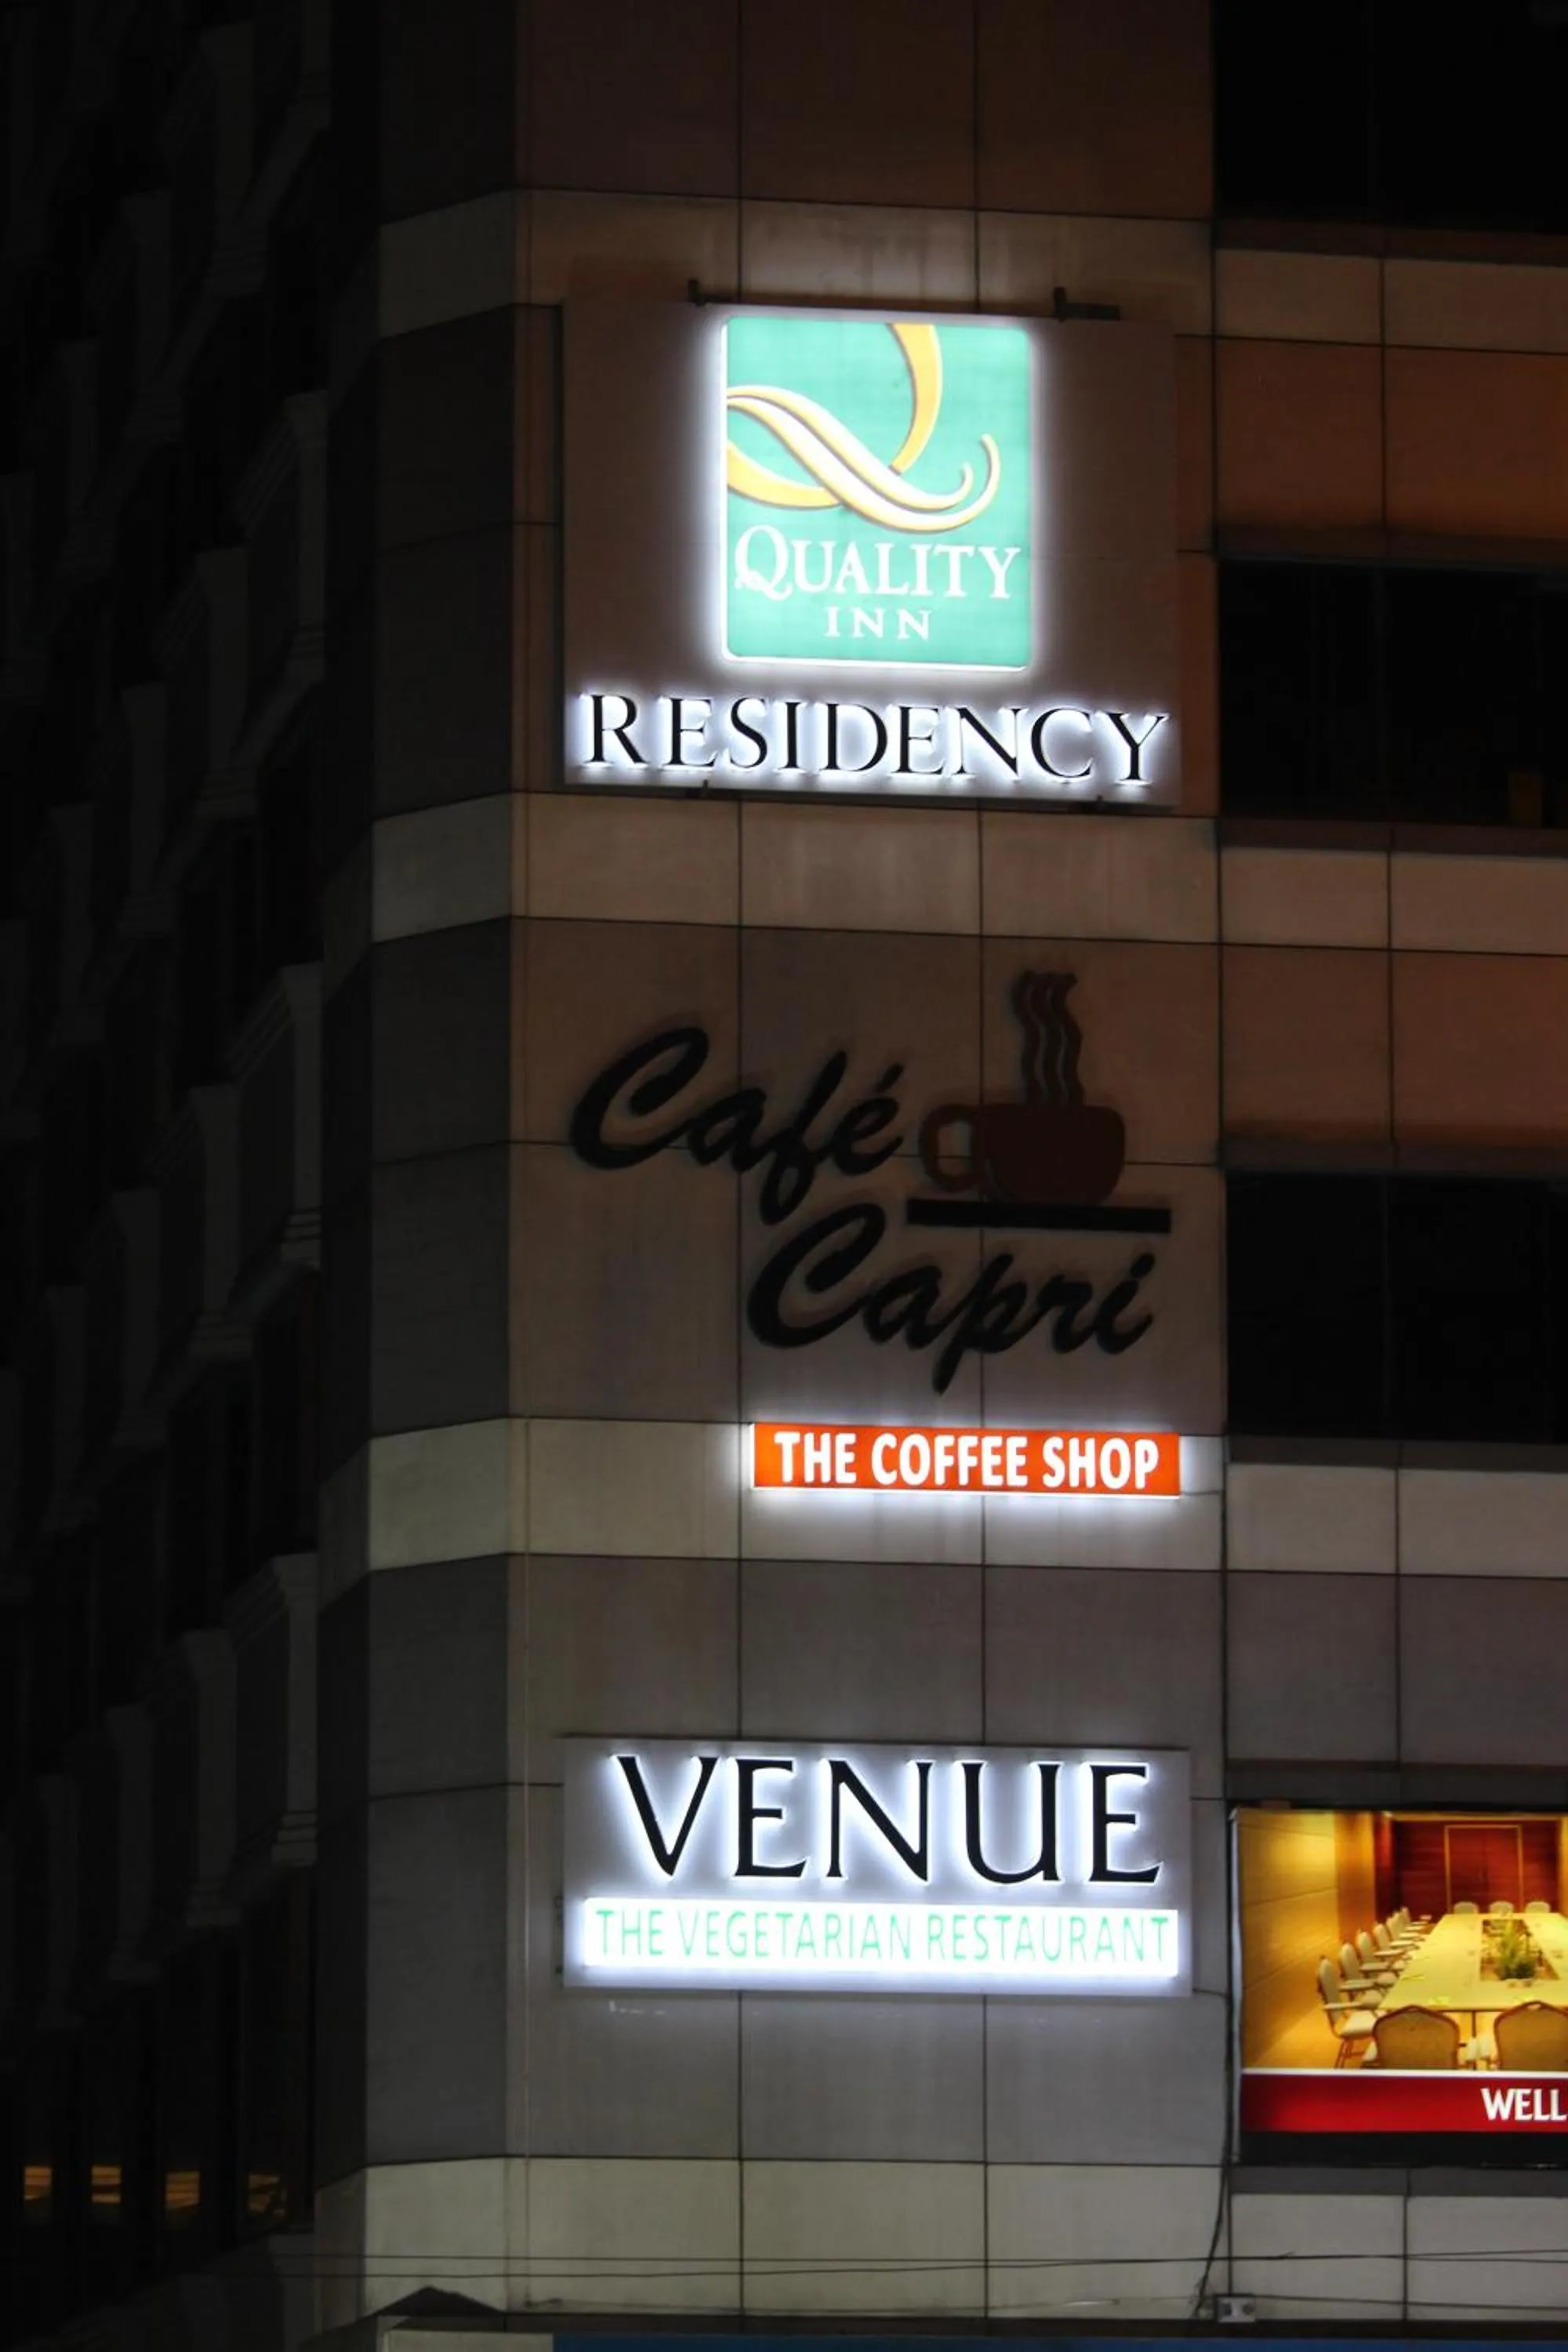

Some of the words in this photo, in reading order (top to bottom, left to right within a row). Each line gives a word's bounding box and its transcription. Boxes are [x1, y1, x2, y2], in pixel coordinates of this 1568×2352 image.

[735, 524, 1021, 601] QUALITY
[824, 607, 932, 641] INN
[583, 693, 1169, 784] RESIDENCY
[570, 1027, 904, 1225] Café
[746, 1203, 1156, 1394] Capri
[774, 1431, 857, 1484] THE
[872, 1433, 1029, 1486] COFFEE
[1042, 1436, 1160, 1490] SHOP
[613, 1755, 1163, 1885] VENUE
[596, 1909, 664, 1957] THE
[679, 1911, 911, 1960] VEGETARIAN
[928, 1914, 1169, 1962] RESTAURANT
[1480, 2087, 1567, 2122] WELL
